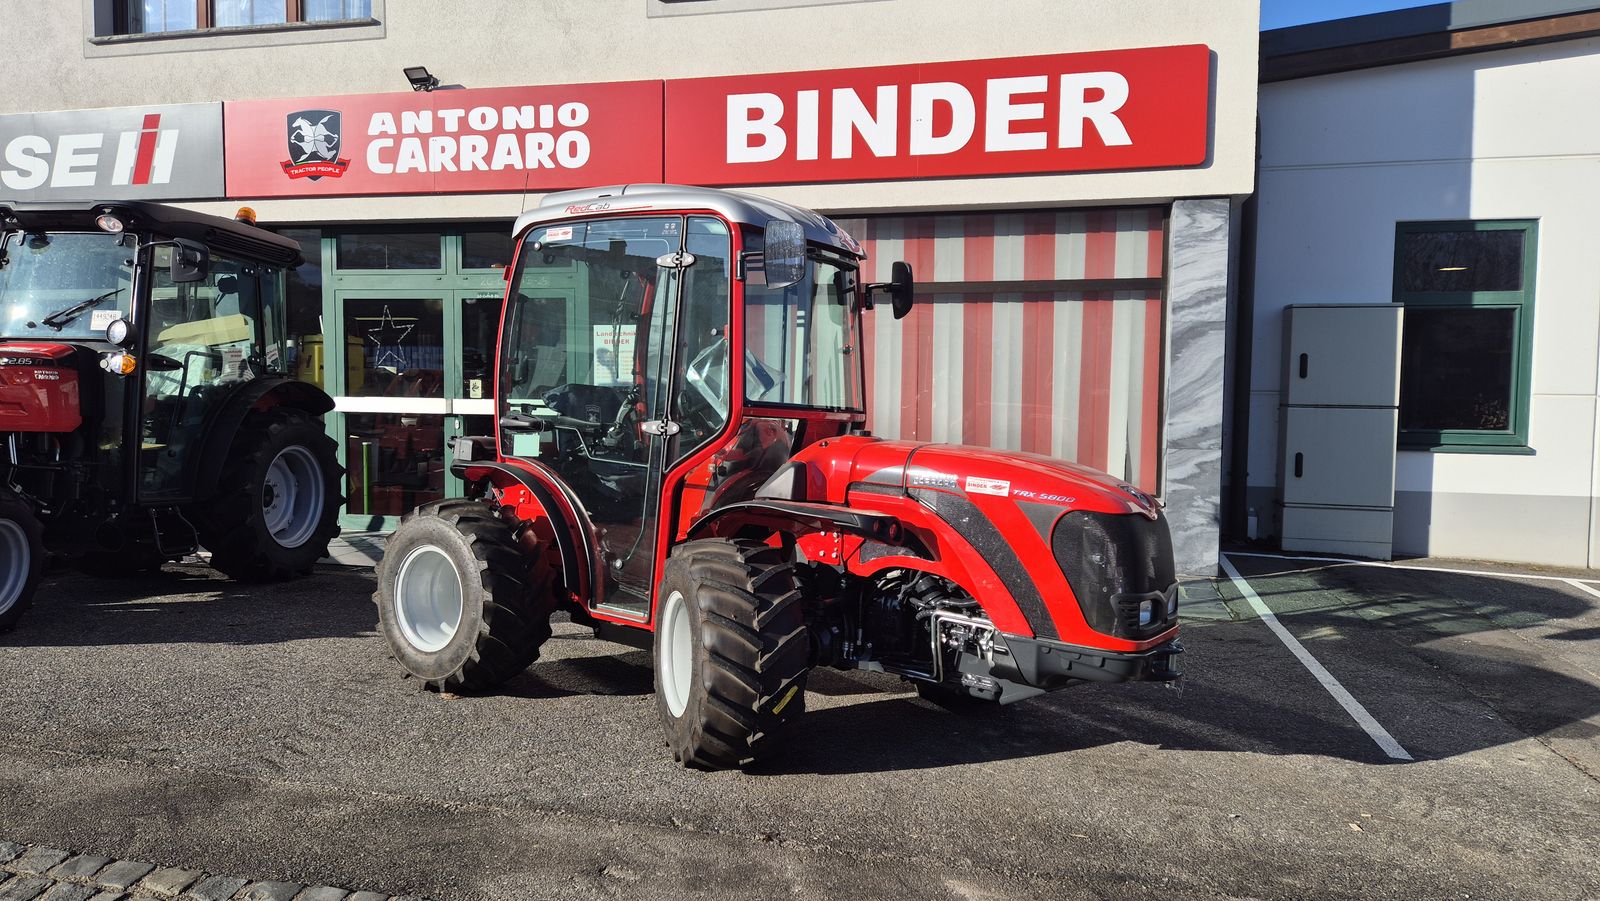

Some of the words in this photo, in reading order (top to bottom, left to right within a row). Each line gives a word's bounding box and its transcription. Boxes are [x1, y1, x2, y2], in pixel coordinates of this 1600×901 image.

[367, 102, 589, 135] ANTONIO
[727, 70, 1133, 164] BINDER
[0, 133, 104, 190] SE
[290, 166, 317, 175] TRACTOR
[366, 130, 591, 174] CARRARO
[1013, 489, 1036, 498] TRX
[1039, 493, 1076, 503] 5800
